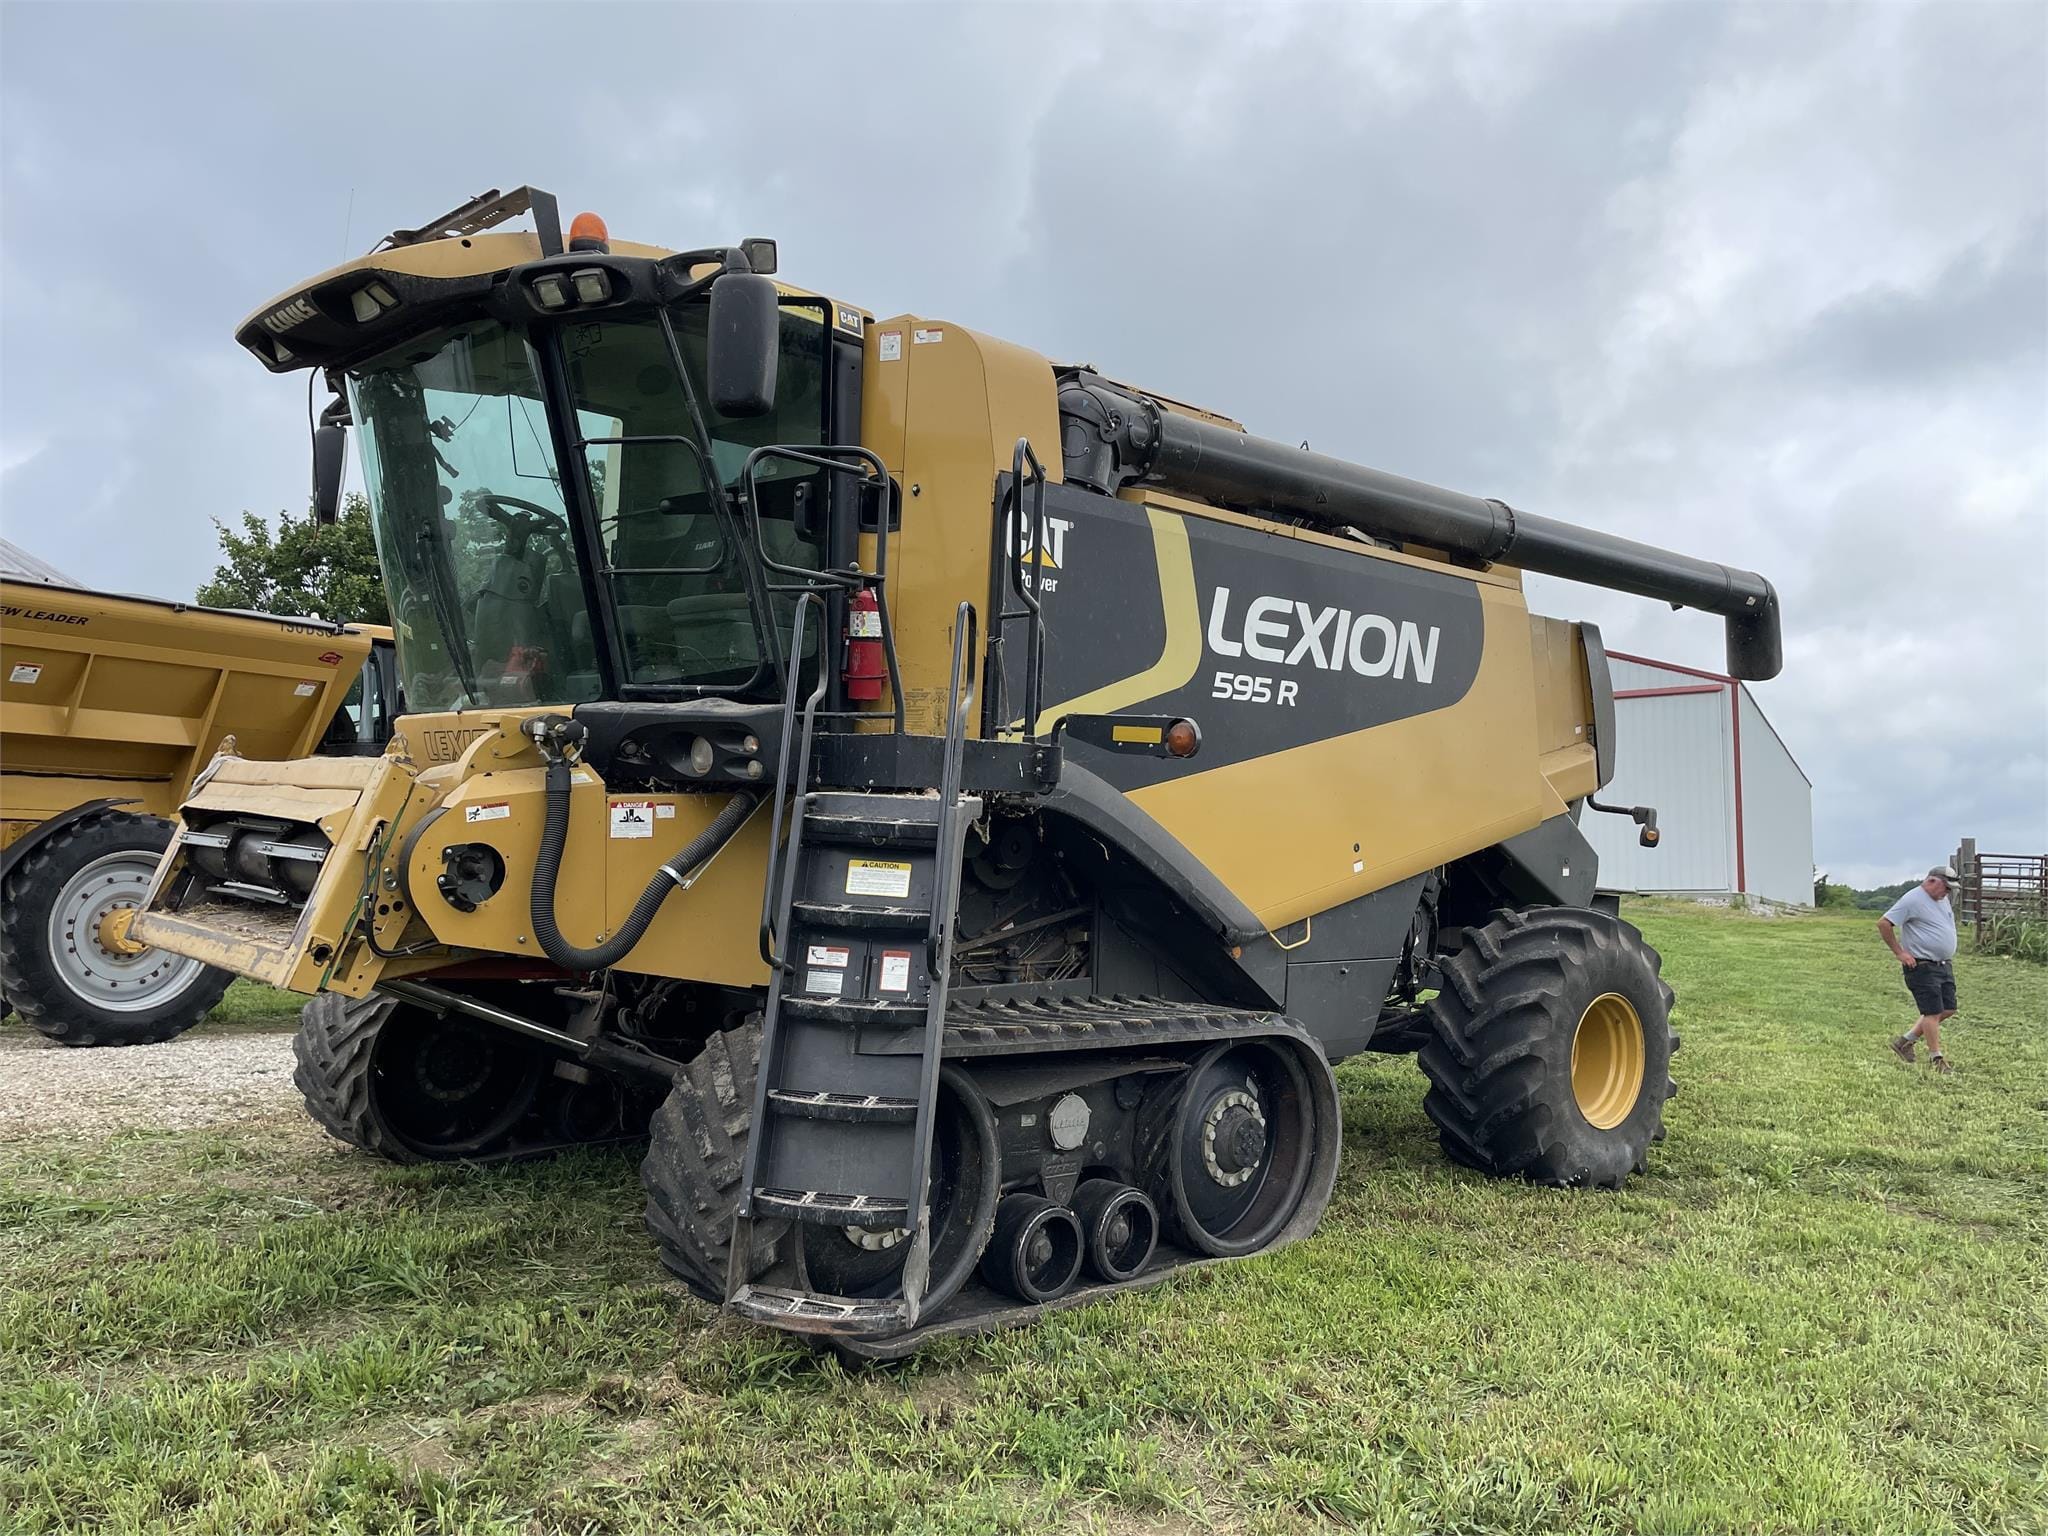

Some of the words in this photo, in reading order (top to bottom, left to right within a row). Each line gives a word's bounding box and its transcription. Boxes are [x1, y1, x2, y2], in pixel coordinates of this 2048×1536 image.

[840, 312, 859, 328] CAT
[23, 610, 89, 625] LEADER
[1207, 586, 1440, 684] LEXION
[1211, 671, 1273, 704] 595
[1276, 680, 1299, 707] R
